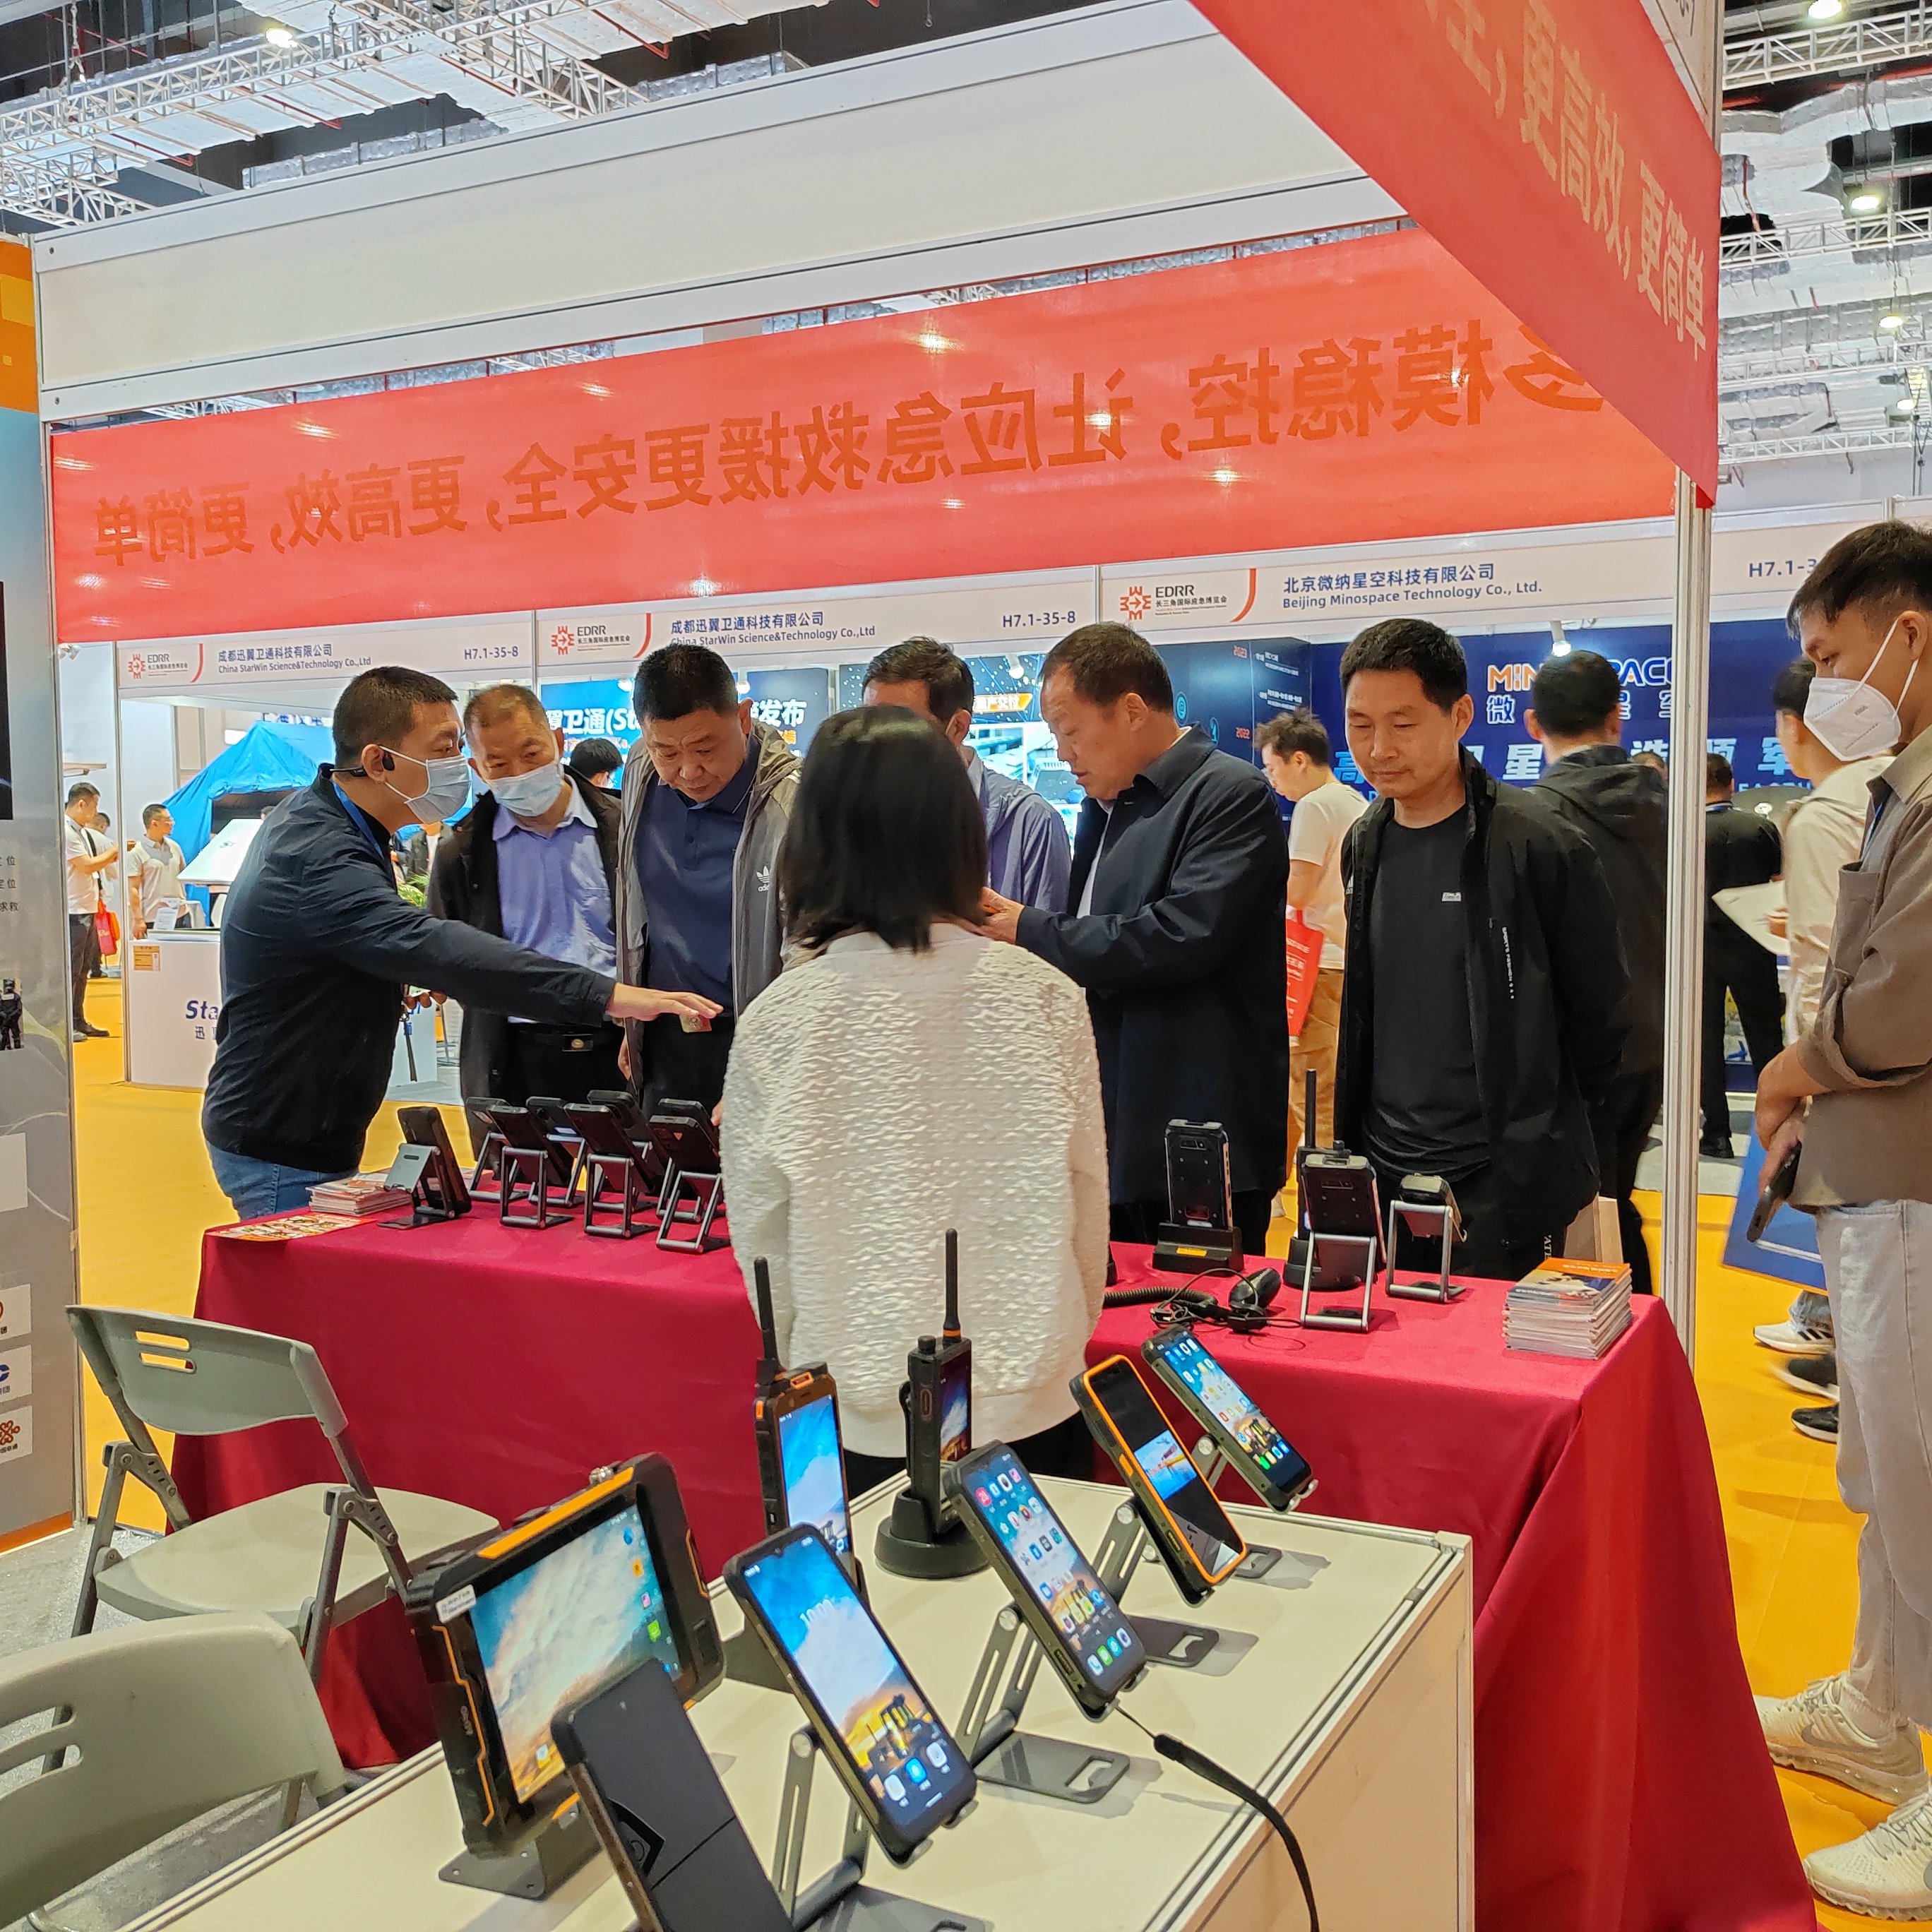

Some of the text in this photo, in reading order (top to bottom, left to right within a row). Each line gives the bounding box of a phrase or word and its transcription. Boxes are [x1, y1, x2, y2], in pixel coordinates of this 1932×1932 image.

[1283, 563, 1494, 594] 北京微纳星空科技有限公司
[1155, 585, 1195, 598] EDRR
[1282, 581, 1542, 609] Beijing Minospace Technology Co., Ltd.
[1155, 595, 1227, 607] 长三角国际应急博览会
[671, 611, 824, 634] 成都迅翼卫通科技有限公司
[1002, 610, 1076, 628] H7.1-35-8
[577, 625, 607, 636] EDRR
[699, 634, 736, 645] StarWin
[738, 629, 837, 644] Science&Technology
[148, 653, 170, 664] EDRR
[218, 643, 333, 663] 成都迅翼卫通科技有限公司
[464, 645, 519, 660] H7.1-35-8
[218, 664, 239, 674] China
[240, 662, 268, 673] StarWin
[270, 658, 343, 671] Science&Technology
